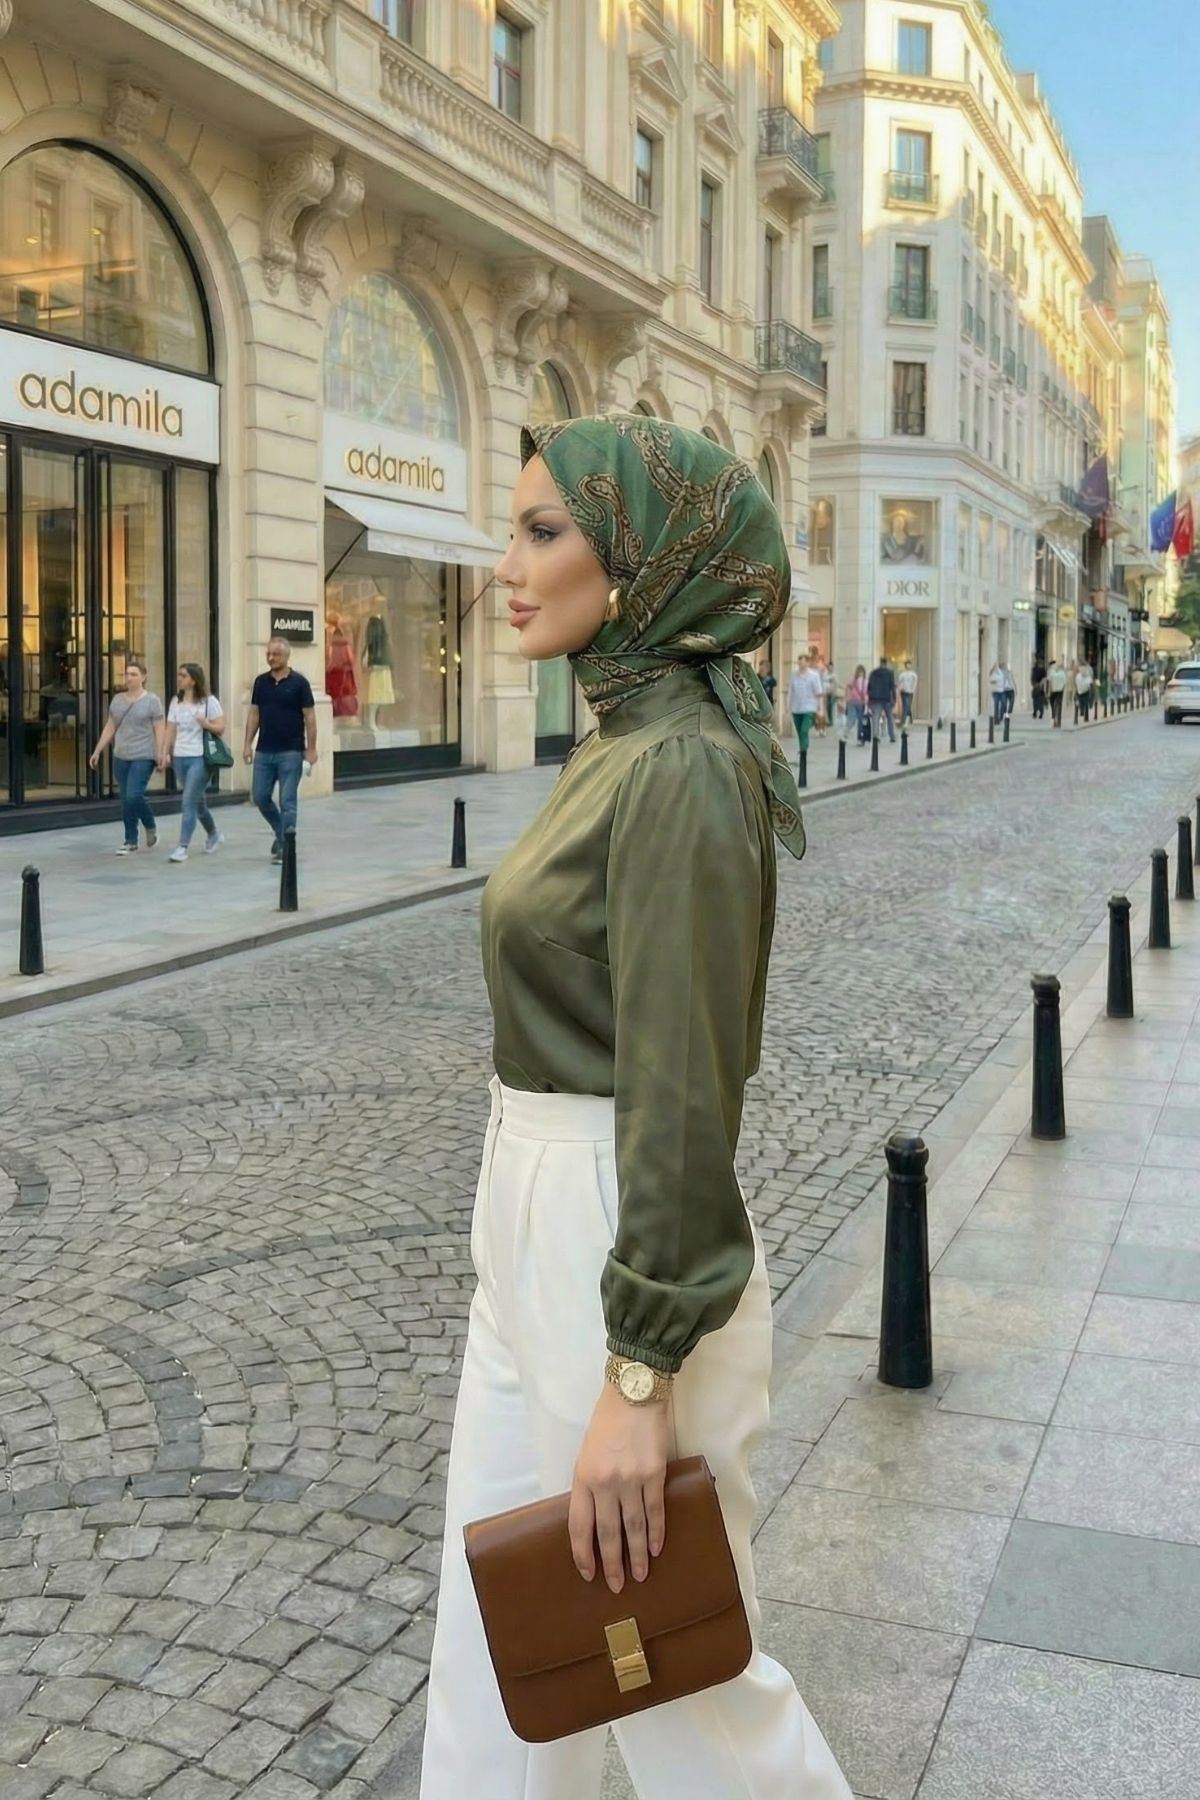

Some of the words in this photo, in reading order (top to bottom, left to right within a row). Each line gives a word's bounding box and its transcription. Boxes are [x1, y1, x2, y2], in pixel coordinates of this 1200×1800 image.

[19, 370, 183, 437] adamila
[347, 443, 445, 492] adamila
[887, 580, 930, 597] DIOR
